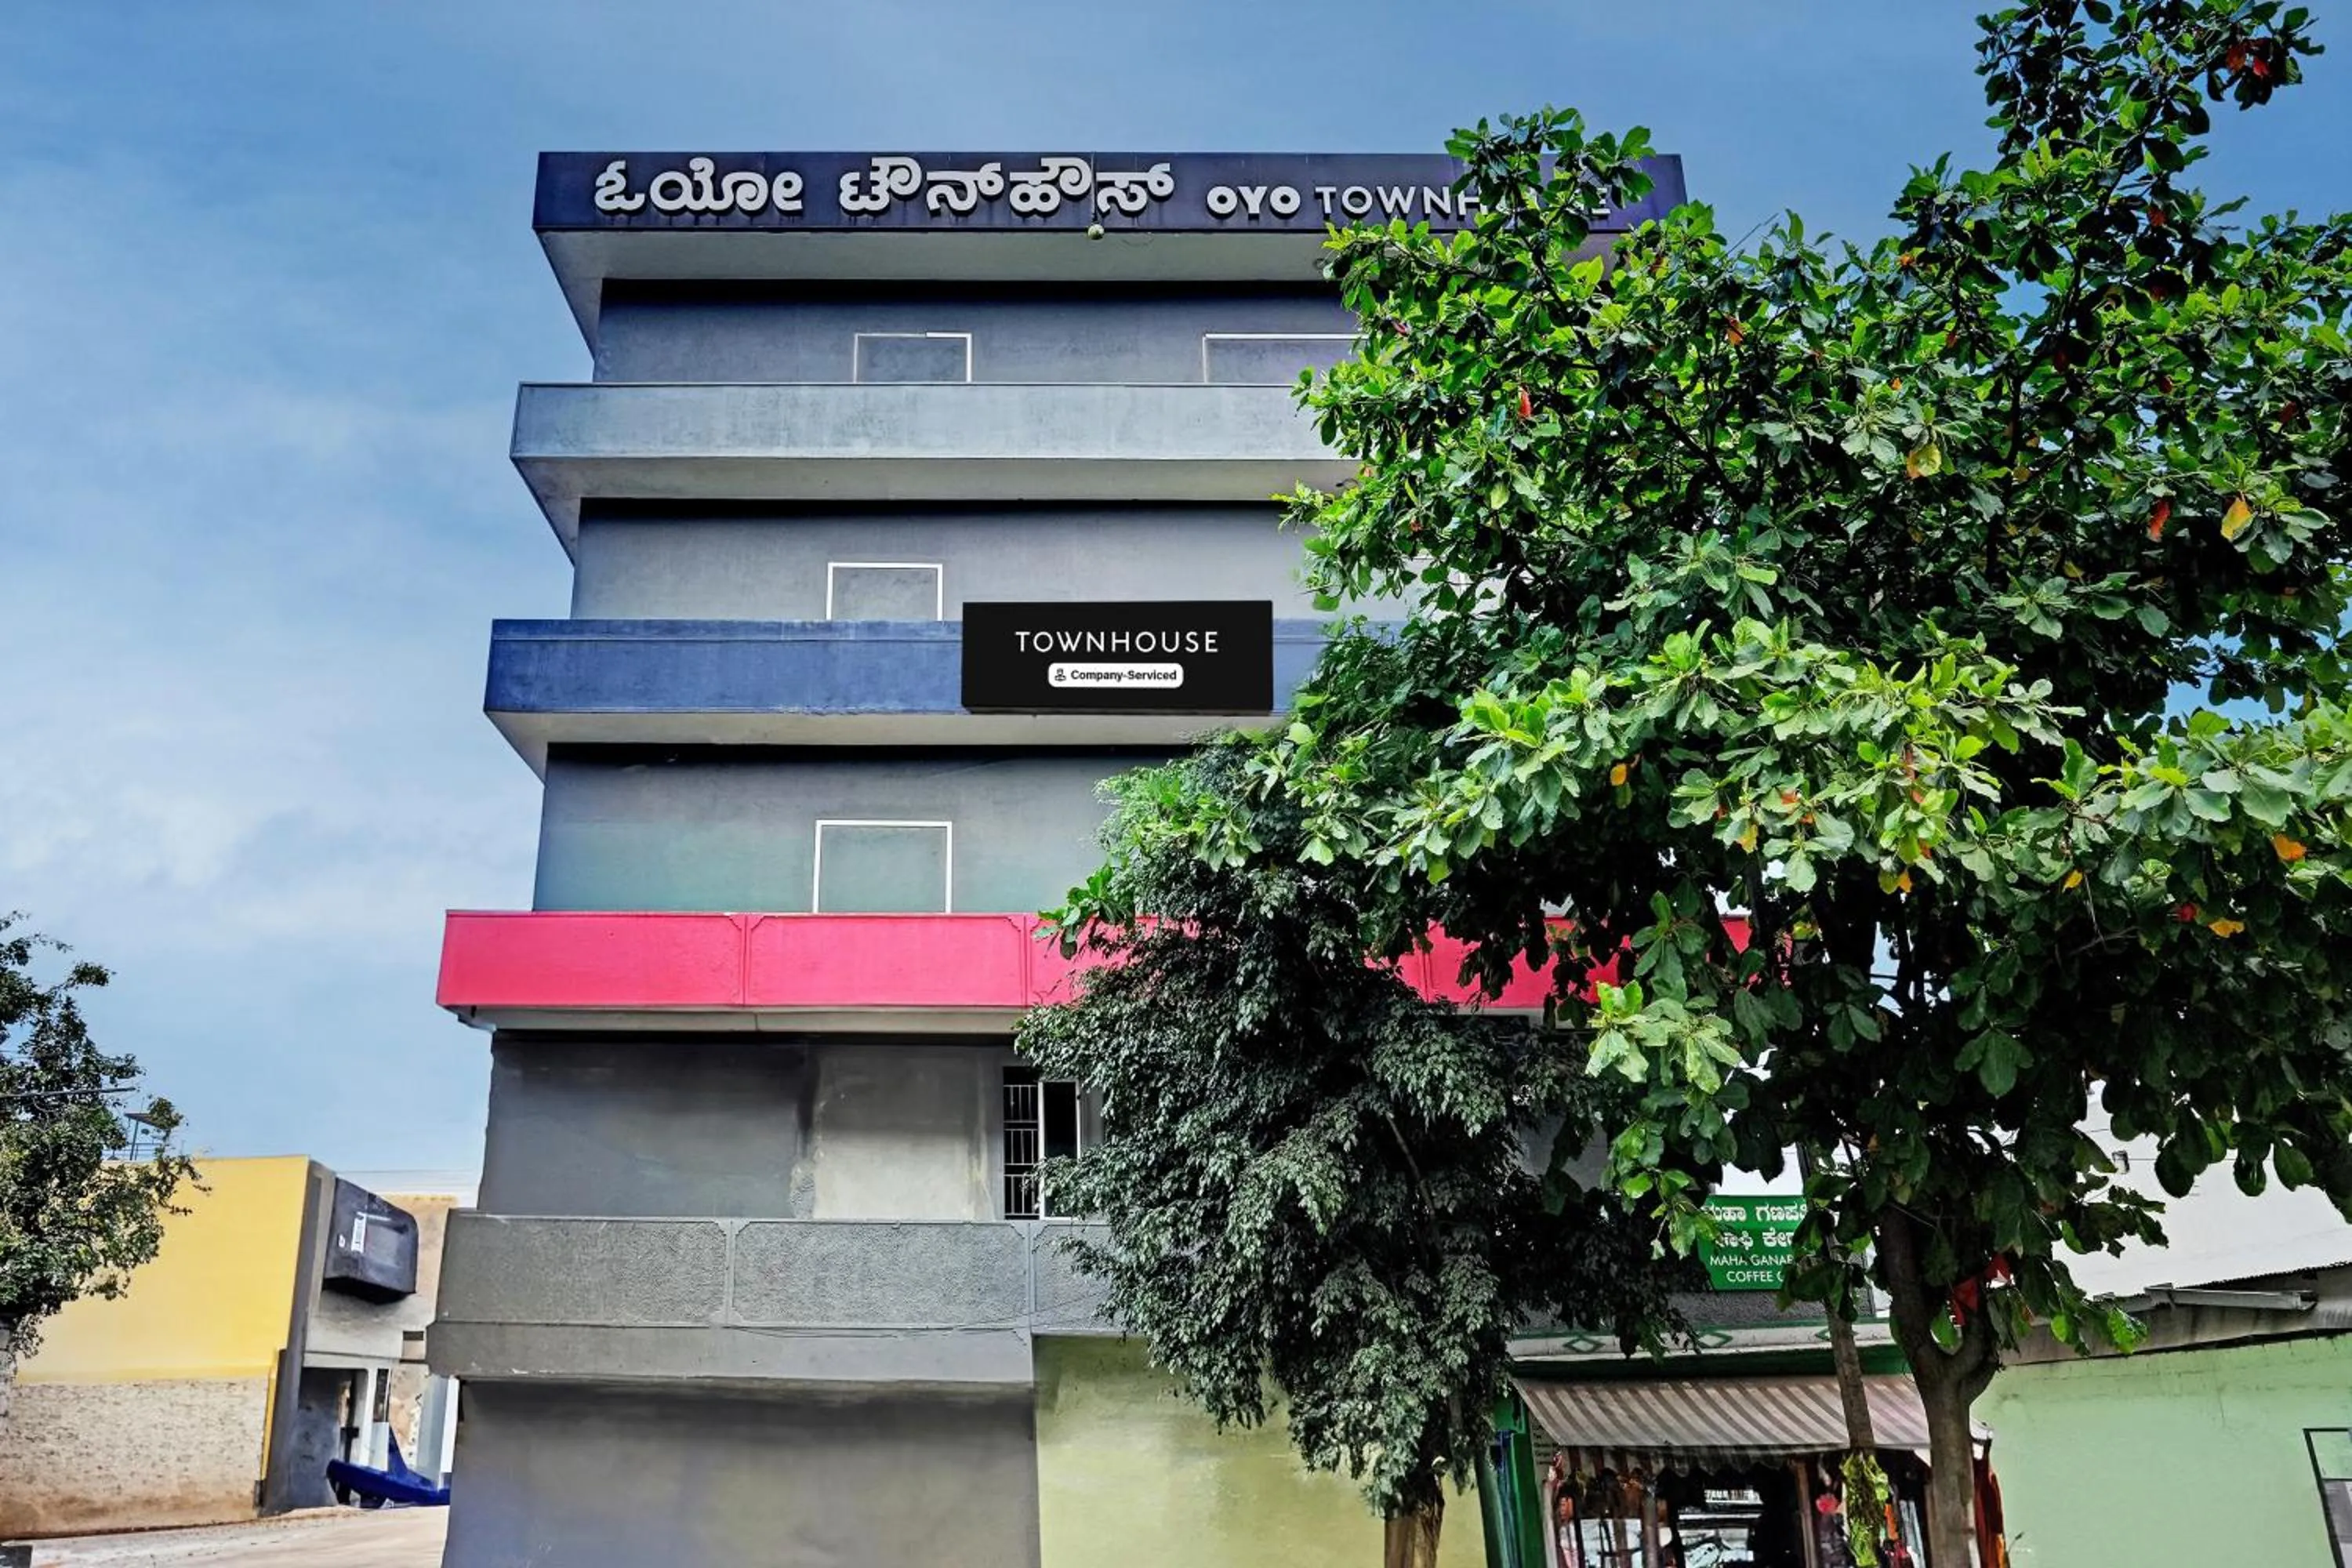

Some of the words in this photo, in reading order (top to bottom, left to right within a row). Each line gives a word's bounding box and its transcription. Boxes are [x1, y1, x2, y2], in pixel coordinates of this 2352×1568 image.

[1207, 186, 1301, 214] OYO
[1015, 631, 1219, 653] TOWNHOUSE
[1070, 669, 1178, 681] Company-Serviced
[1710, 1255, 1747, 1266] MAHA
[1726, 1271, 1773, 1282] COFFEE
